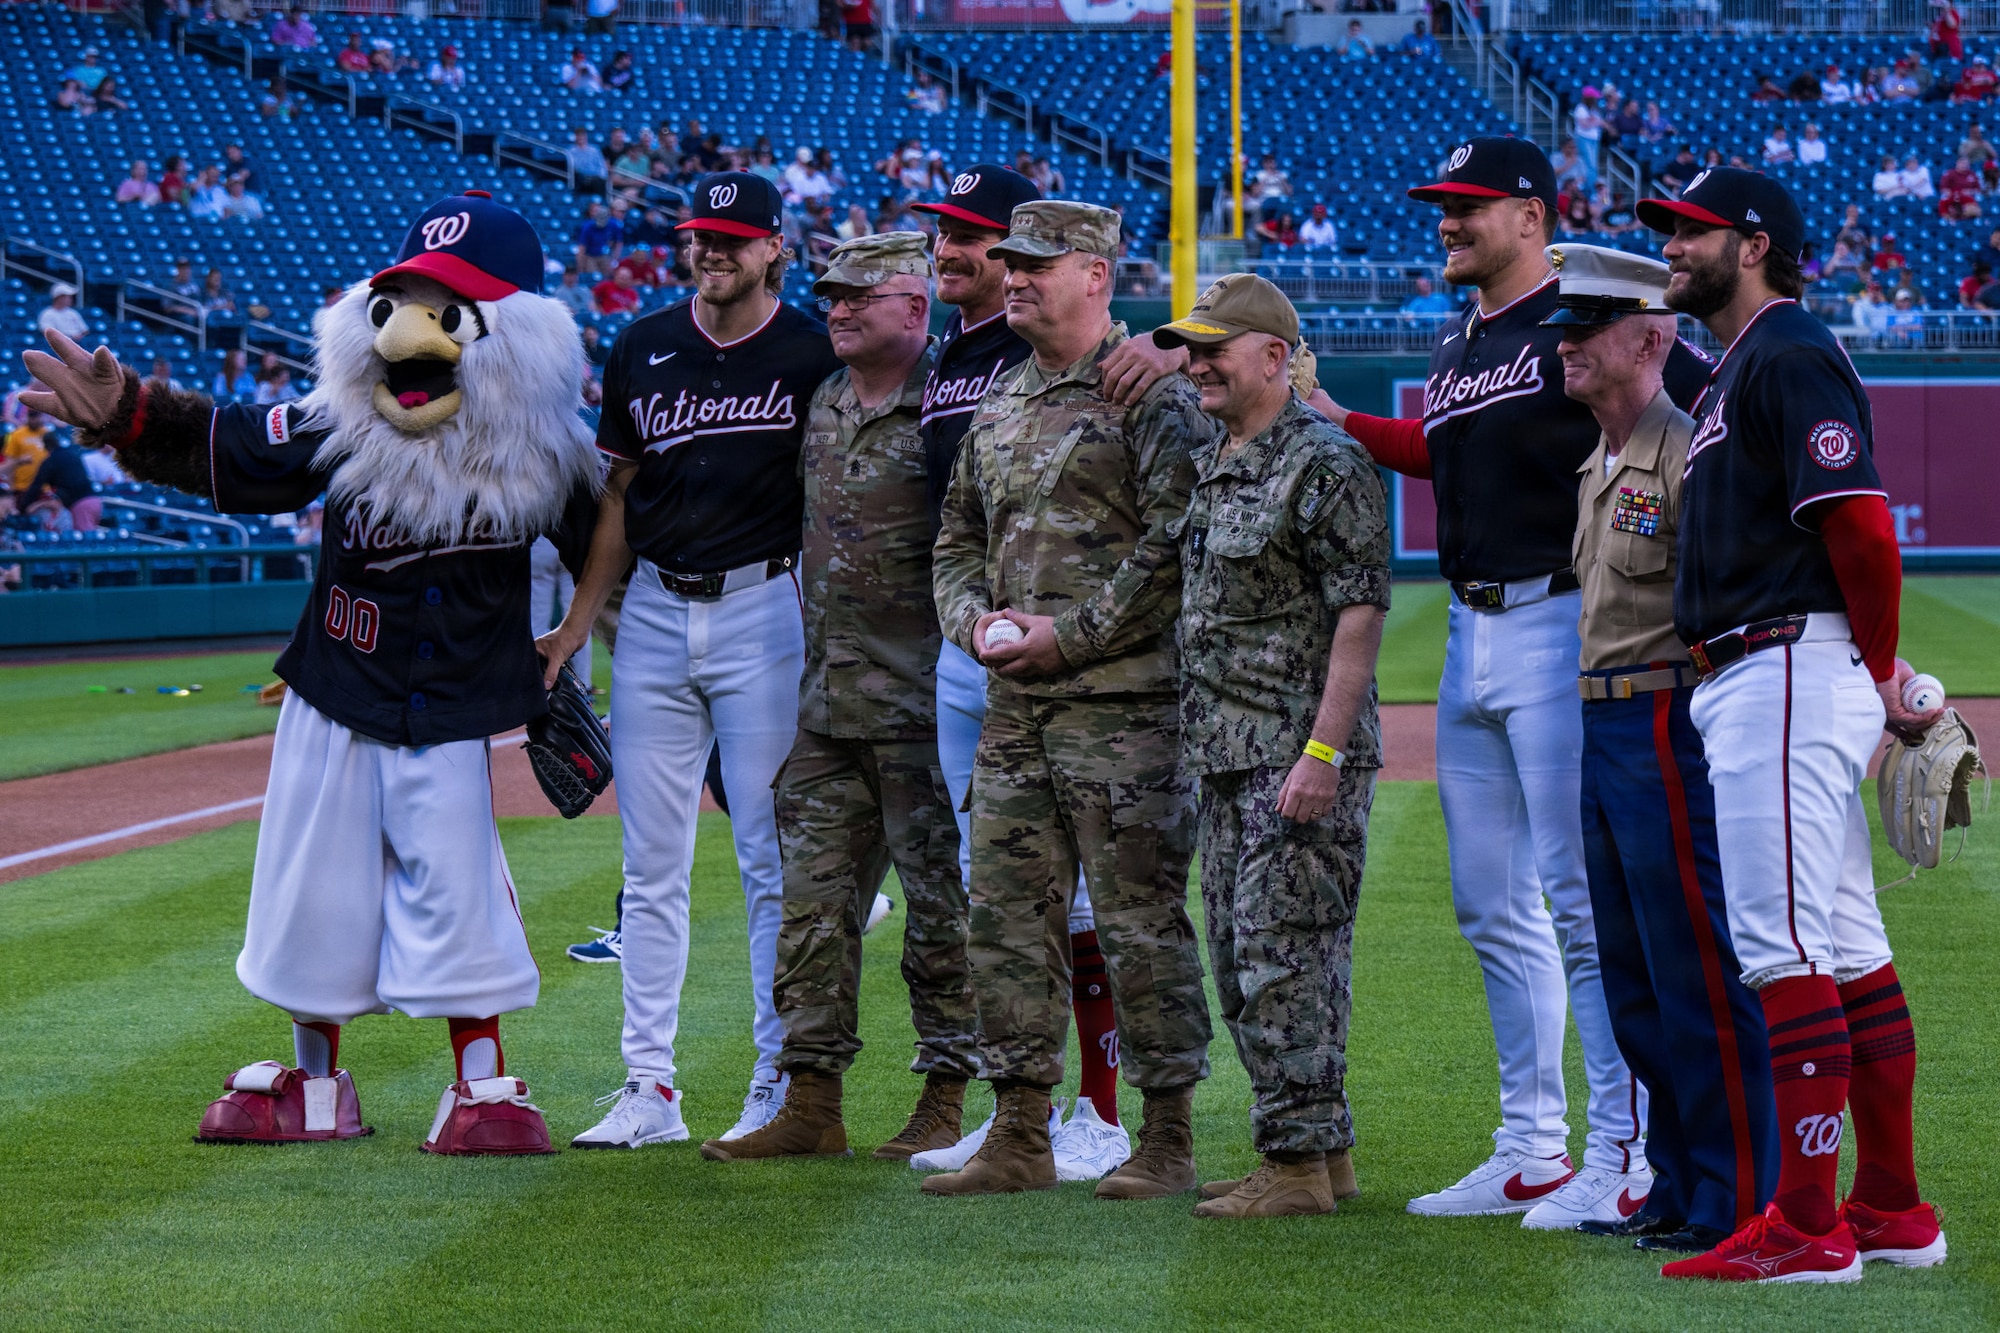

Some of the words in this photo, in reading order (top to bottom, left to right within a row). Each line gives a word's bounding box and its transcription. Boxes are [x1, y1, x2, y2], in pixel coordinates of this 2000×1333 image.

[1447, 143, 1473, 172] W
[708, 182, 738, 210] W
[951, 172, 981, 195] W
[421, 211, 471, 251] W
[271, 407, 284, 440] AARP
[628, 377, 797, 449] Nationals
[1810, 421, 1854, 442] WASHINGTON
[1820, 432, 1845, 458] W
[1815, 450, 1856, 468] NATIONALS
[1240, 509, 1260, 524] NAVY
[1485, 588, 1499, 606] 24
[325, 584, 380, 654] 00
[1795, 1110, 1844, 1157] W
